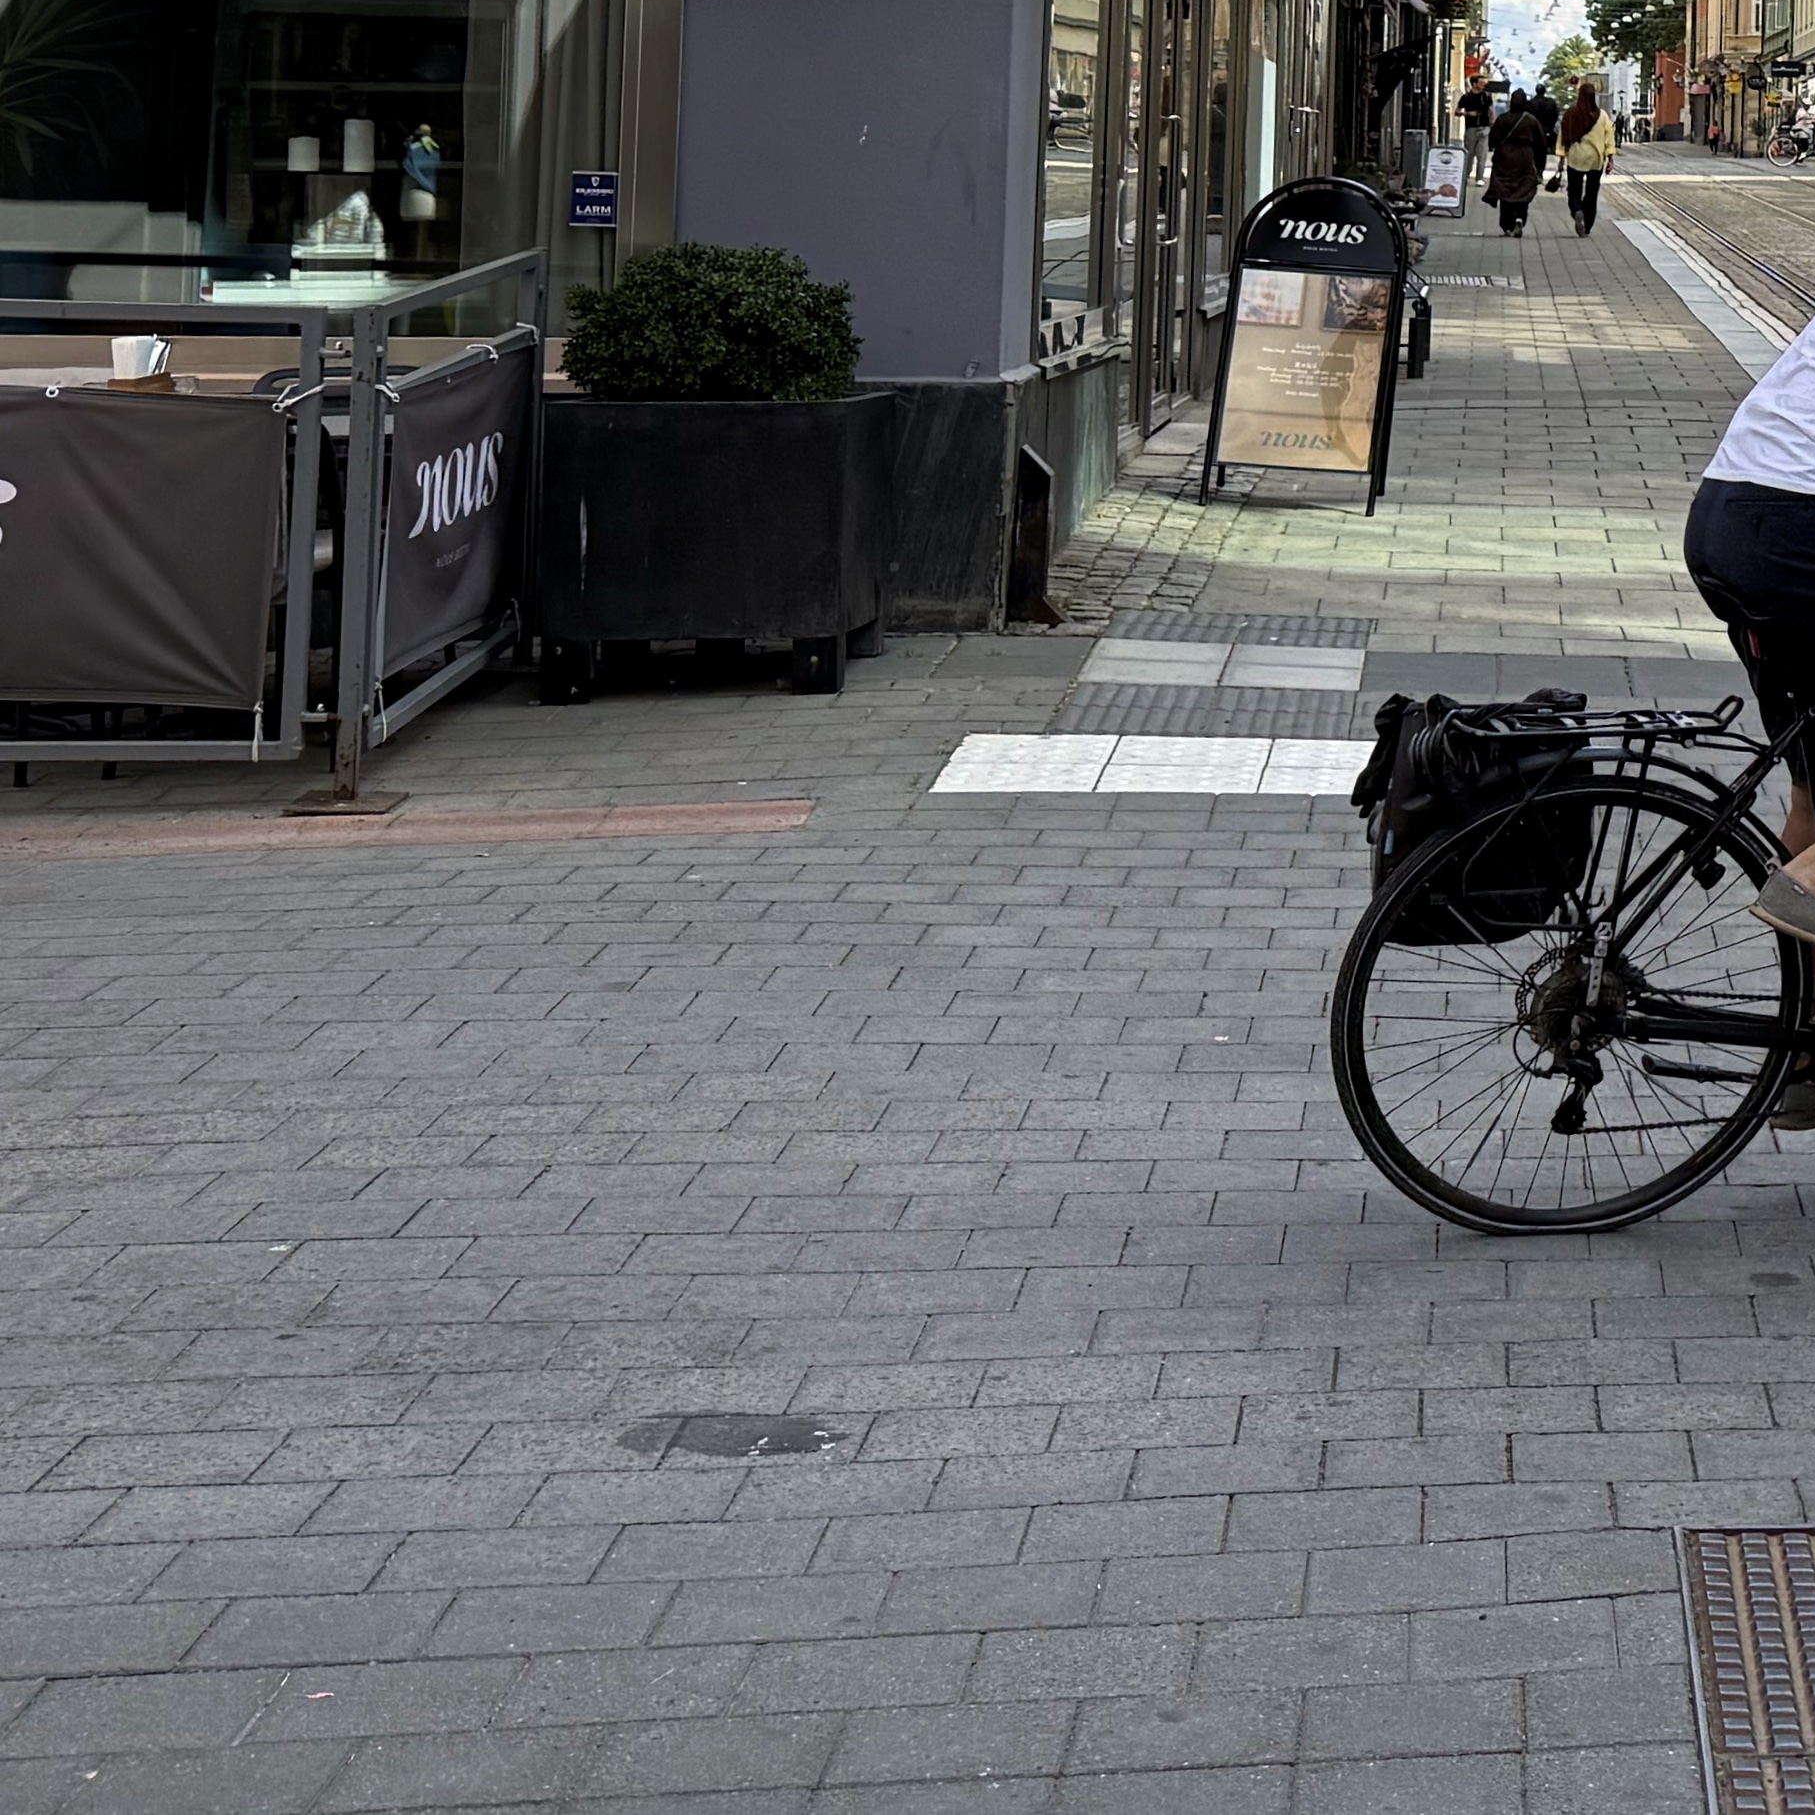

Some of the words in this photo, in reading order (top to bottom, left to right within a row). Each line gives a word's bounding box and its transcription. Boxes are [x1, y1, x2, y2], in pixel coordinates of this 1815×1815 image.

[575, 204, 612, 215] LARM
[1278, 218, 1368, 245] nous
[1260, 430, 1334, 450] nous
[408, 431, 504, 539] nous
